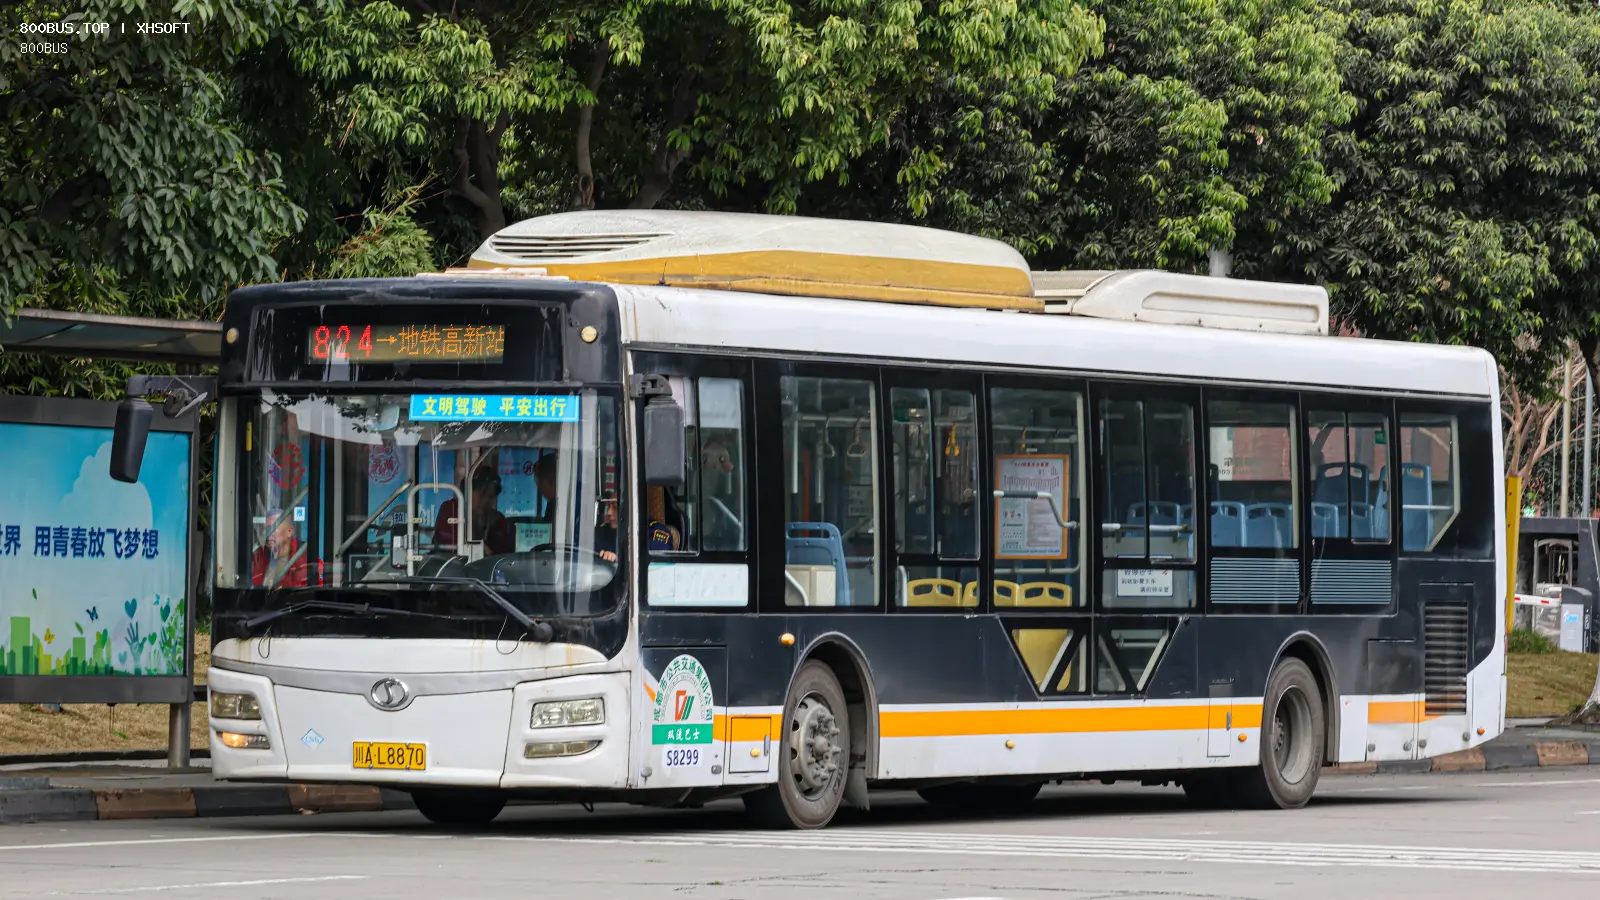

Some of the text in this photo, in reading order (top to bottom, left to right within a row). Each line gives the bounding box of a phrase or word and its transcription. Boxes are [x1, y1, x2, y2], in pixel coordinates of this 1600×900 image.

[314, 323, 504, 358] 824 地铁高新站
[421, 395, 566, 417] 文明驾驶 平安出行
[0, 524, 159, 559] 界 用青春放飞梦想
[666, 749, 699, 767] S8299
